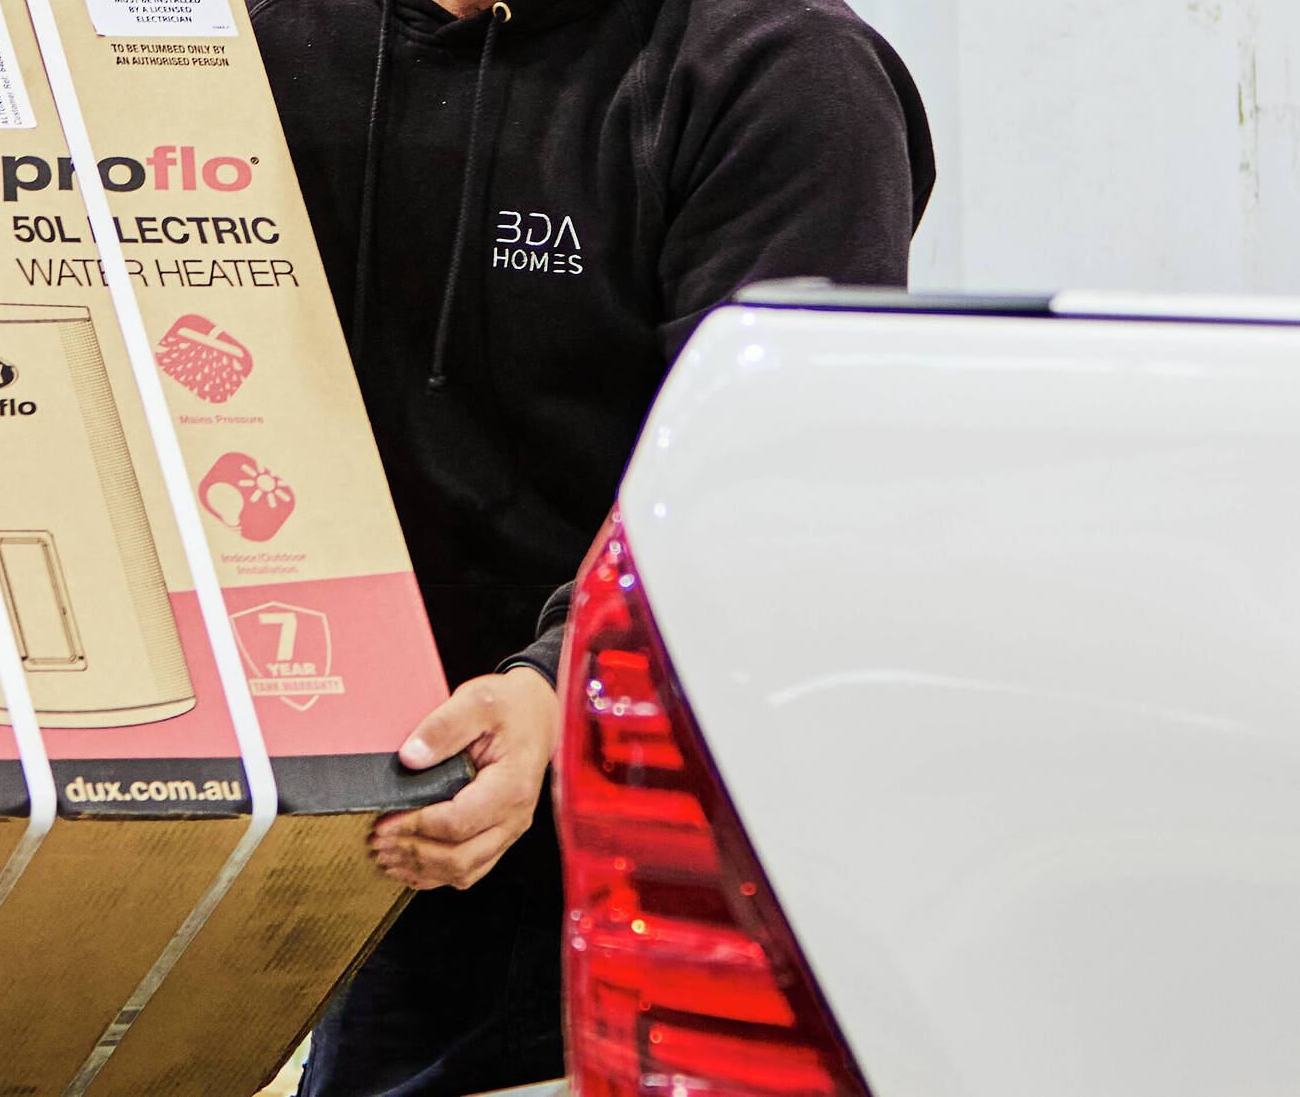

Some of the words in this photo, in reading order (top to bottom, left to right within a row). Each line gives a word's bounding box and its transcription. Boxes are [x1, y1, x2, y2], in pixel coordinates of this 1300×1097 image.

[111, 44, 124, 53] TO
[126, 44, 138, 53] BE
[140, 44, 186, 54] PLUMBED
[187, 45, 210, 54] ONLY
[212, 45, 225, 54] BY
[116, 56, 130, 65] AN
[132, 56, 190, 66] AUTHORISED
[192, 57, 230, 67] PERSON
[1, 145, 253, 202] proflo
[12, 215, 81, 243] 50L
[88, 215, 280, 244] LECTRIC
[496, 210, 581, 250] BDA
[155, 259, 300, 287] HEATER
[492, 247, 584, 275] HOMES
[259, 612, 298, 661] 7
[266, 662, 318, 677] YEAR
[65, 776, 243, 803] dux.com.au
